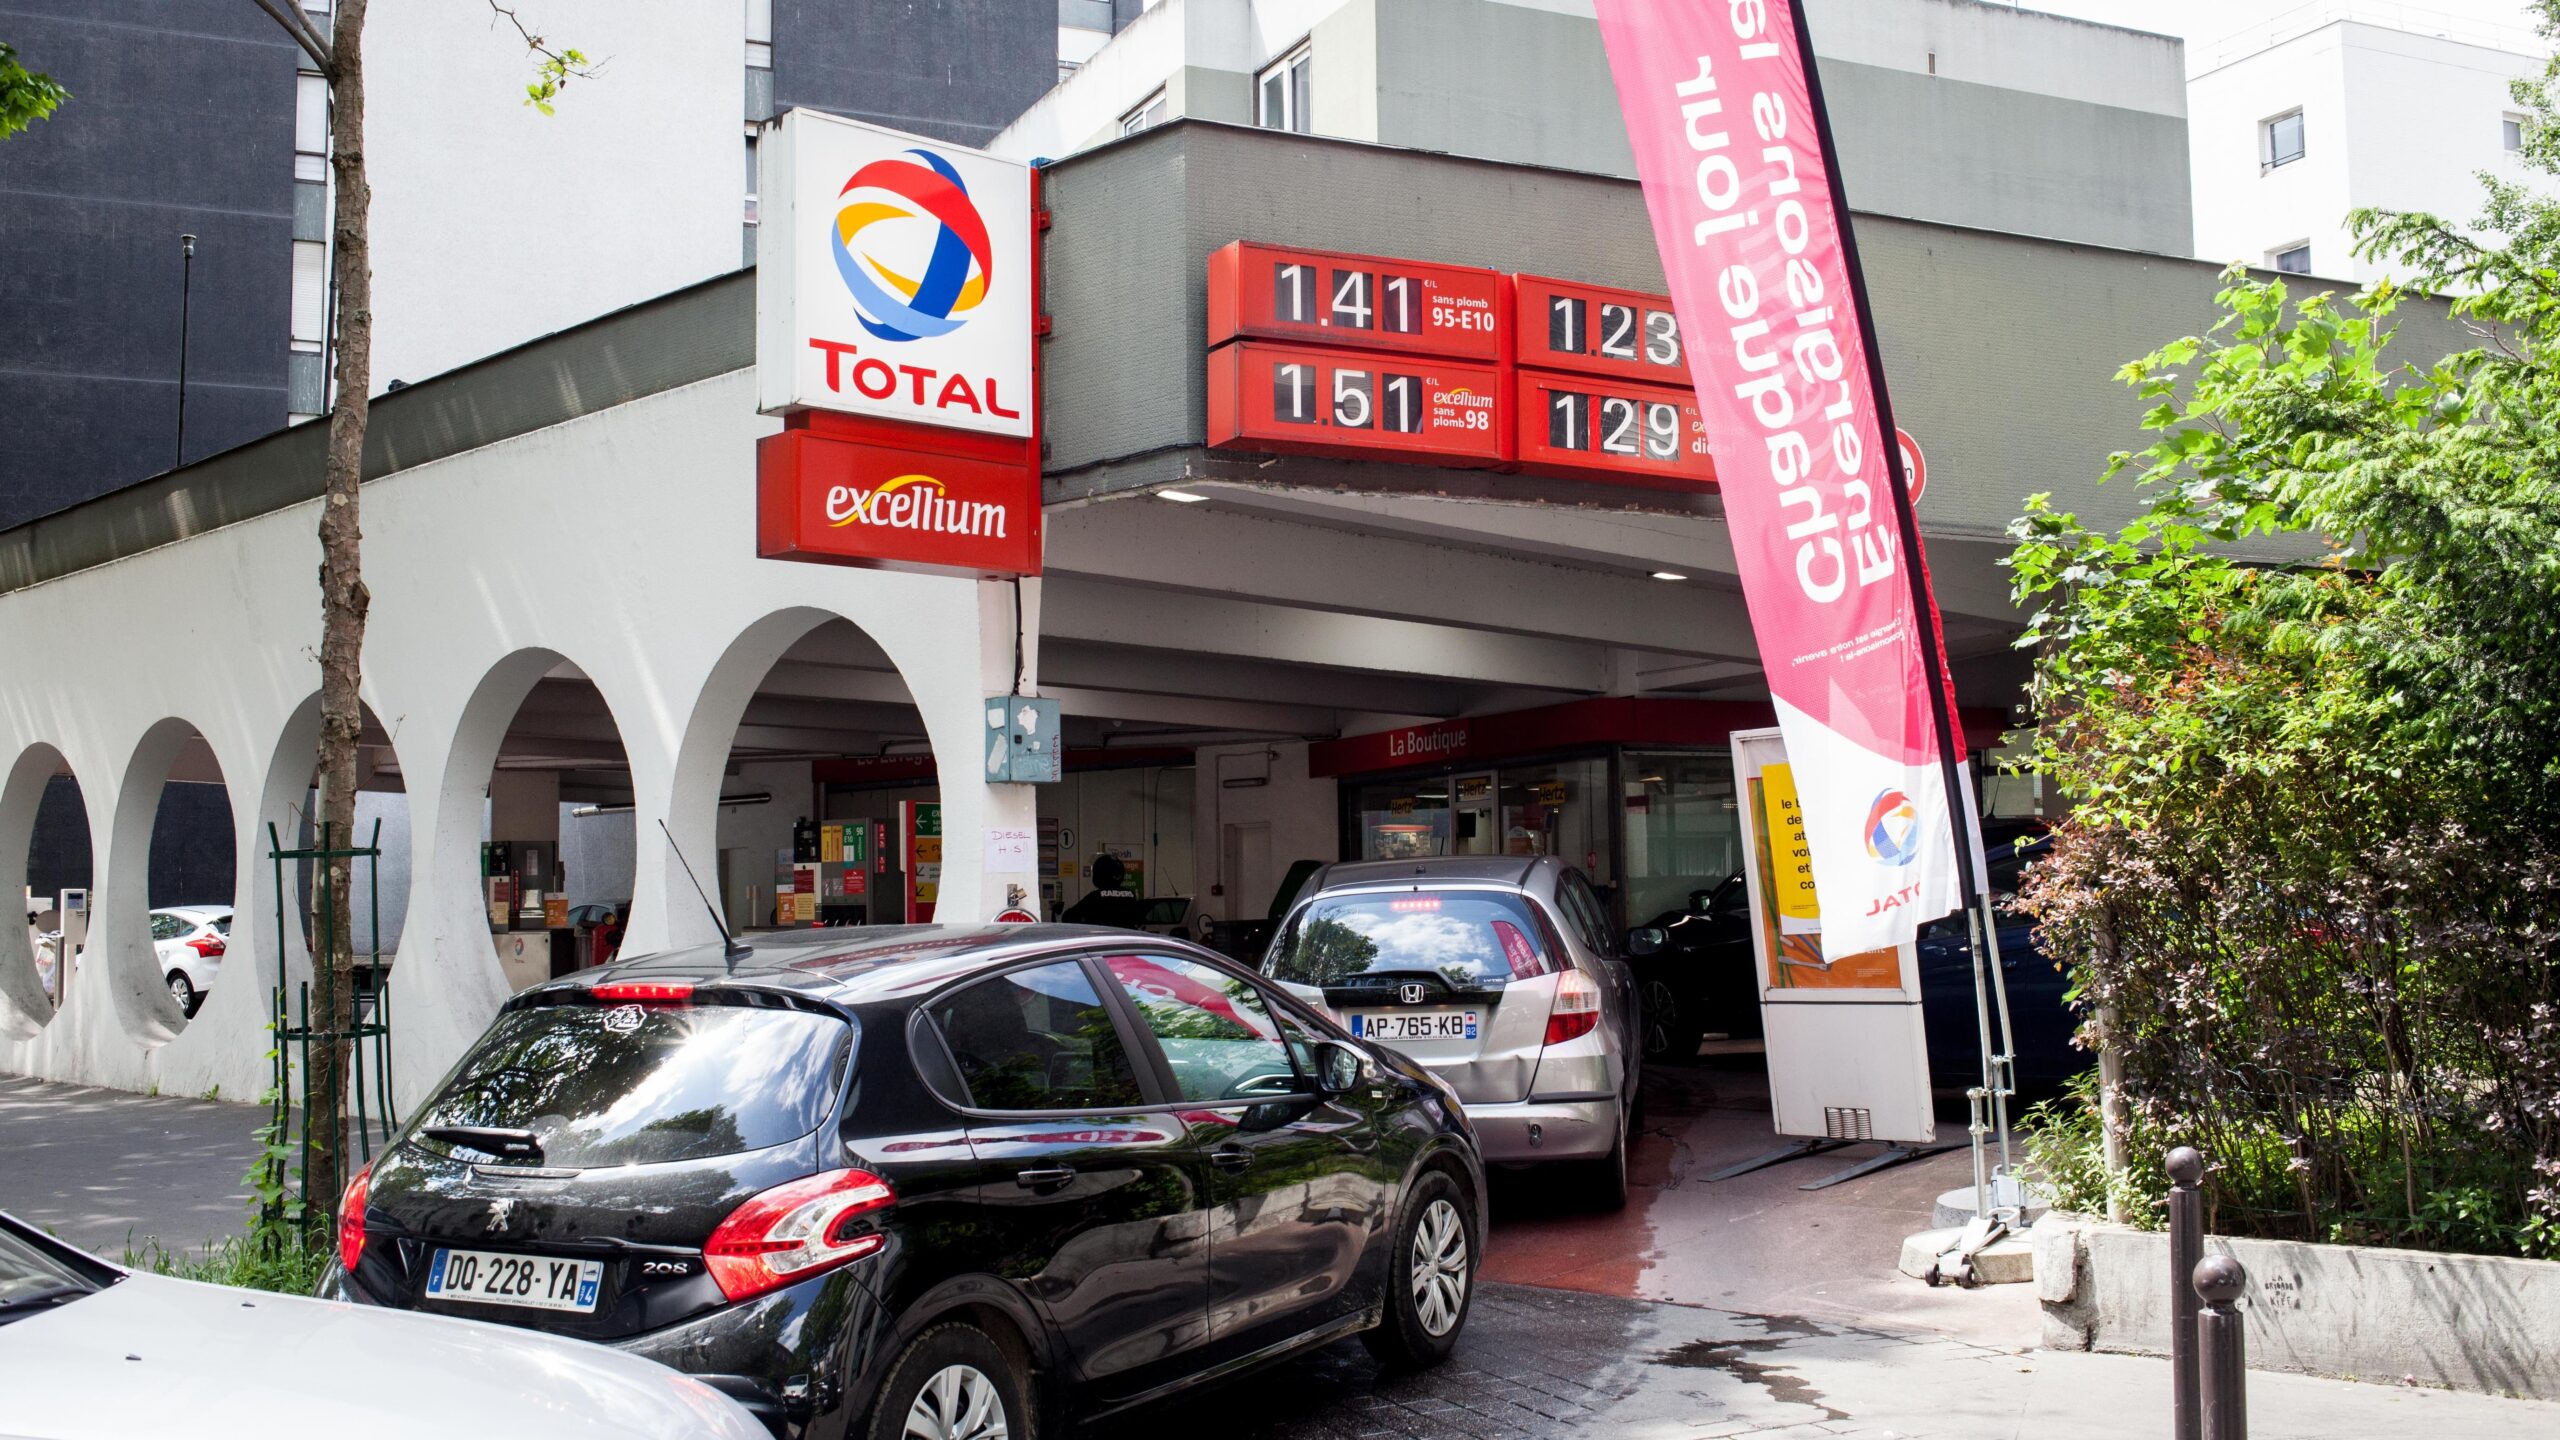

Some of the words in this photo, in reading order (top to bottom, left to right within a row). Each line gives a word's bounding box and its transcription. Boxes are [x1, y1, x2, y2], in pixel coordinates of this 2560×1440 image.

[1432, 295, 1455, 306] sans
[1456, 297, 1489, 309] plomb
[1432, 307, 1495, 332] 95-E10
[809, 337, 1020, 420] TOTAL
[1433, 388, 1493, 409] excellium
[1433, 407, 1456, 417] sans
[1433, 416, 1465, 429] plomb
[1465, 409, 1489, 431] 98
[826, 479, 1007, 539] excellium
[1389, 733, 1405, 757] La
[1407, 727, 1467, 755] Boutique
[1463, 783, 1487, 797] Hertz
[1539, 786, 1566, 802] Hertz
[1781, 799, 1792, 809] le
[992, 830, 1031, 841] DIESEL
[1797, 862, 1810, 873] et
[1100, 889, 1135, 898] RAIDERS
[1365, 1014, 1464, 1038] AP-765-KB
[1466, 1025, 1476, 1036] 92
[643, 1260, 689, 1276] 208
[432, 1275, 440, 1286] F
[445, 1254, 578, 1301] DQ-228-YA
